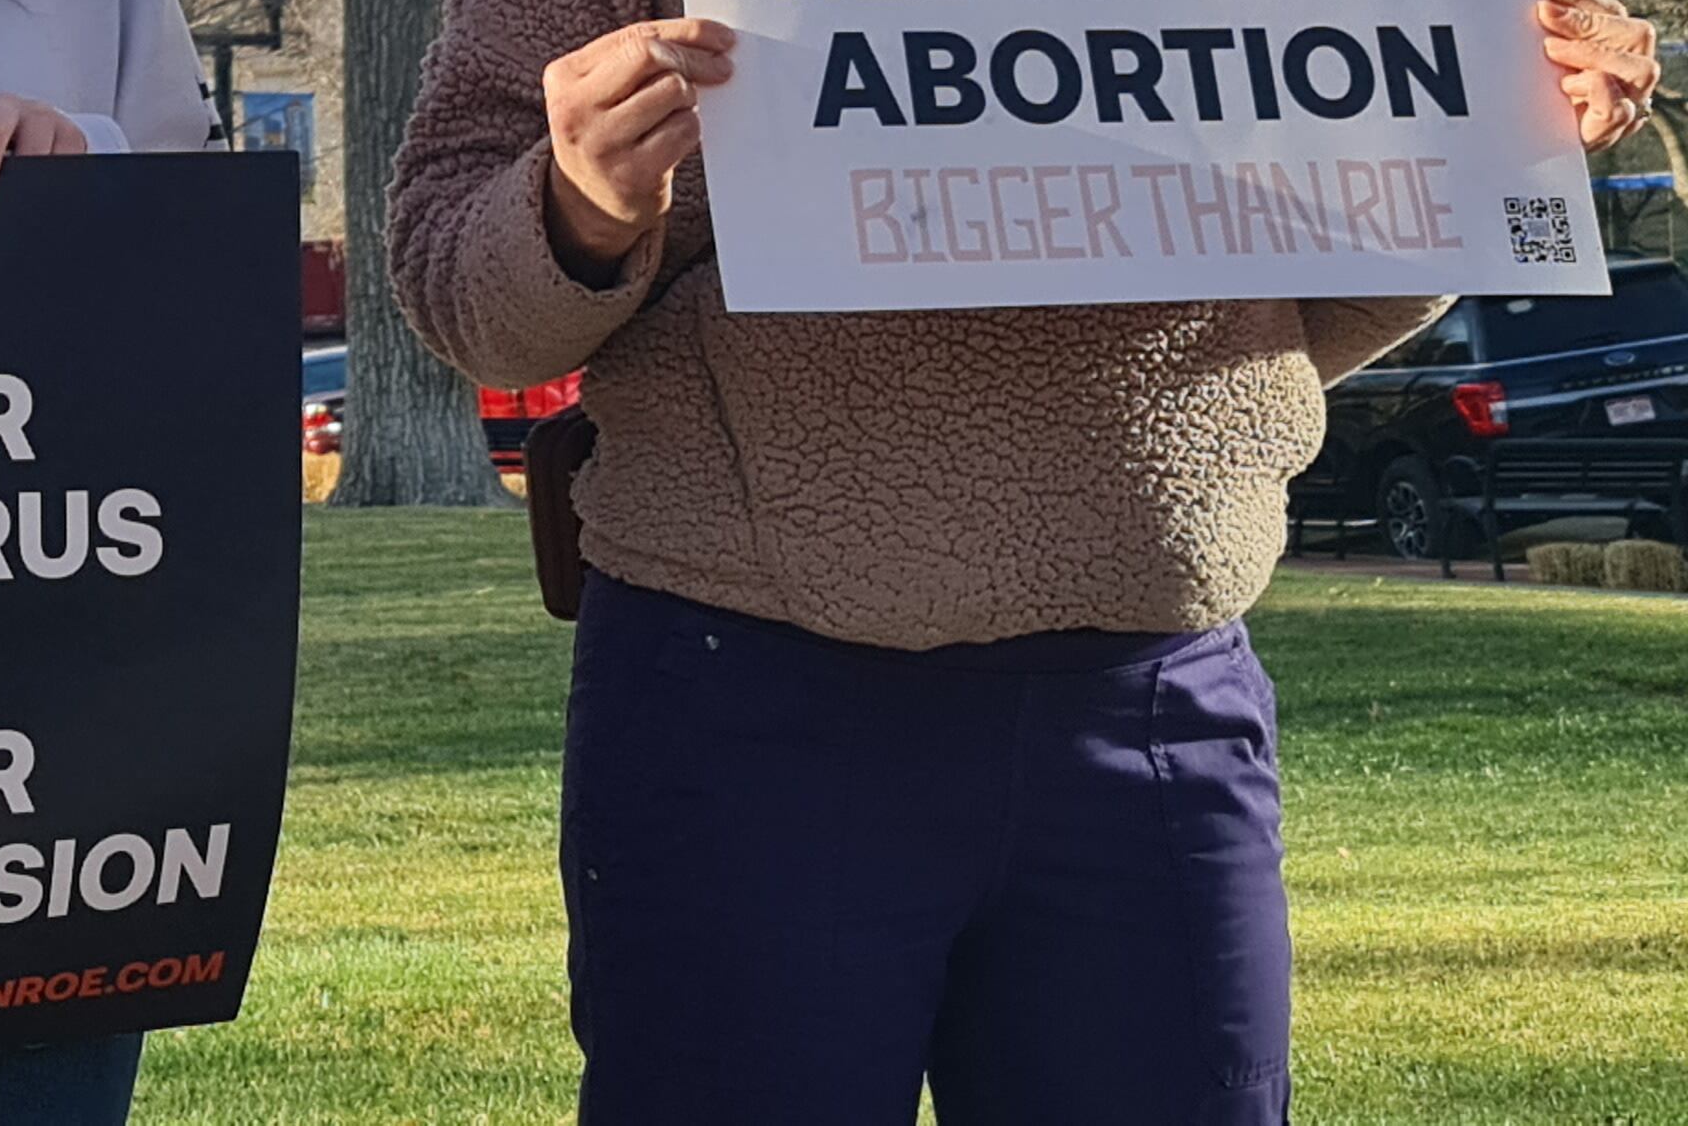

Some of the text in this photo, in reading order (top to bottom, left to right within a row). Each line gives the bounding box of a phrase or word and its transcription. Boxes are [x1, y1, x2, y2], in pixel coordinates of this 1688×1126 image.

[814, 25, 1469, 128] ABORTION
[850, 157, 1464, 264] BIGGER THAN ROE
